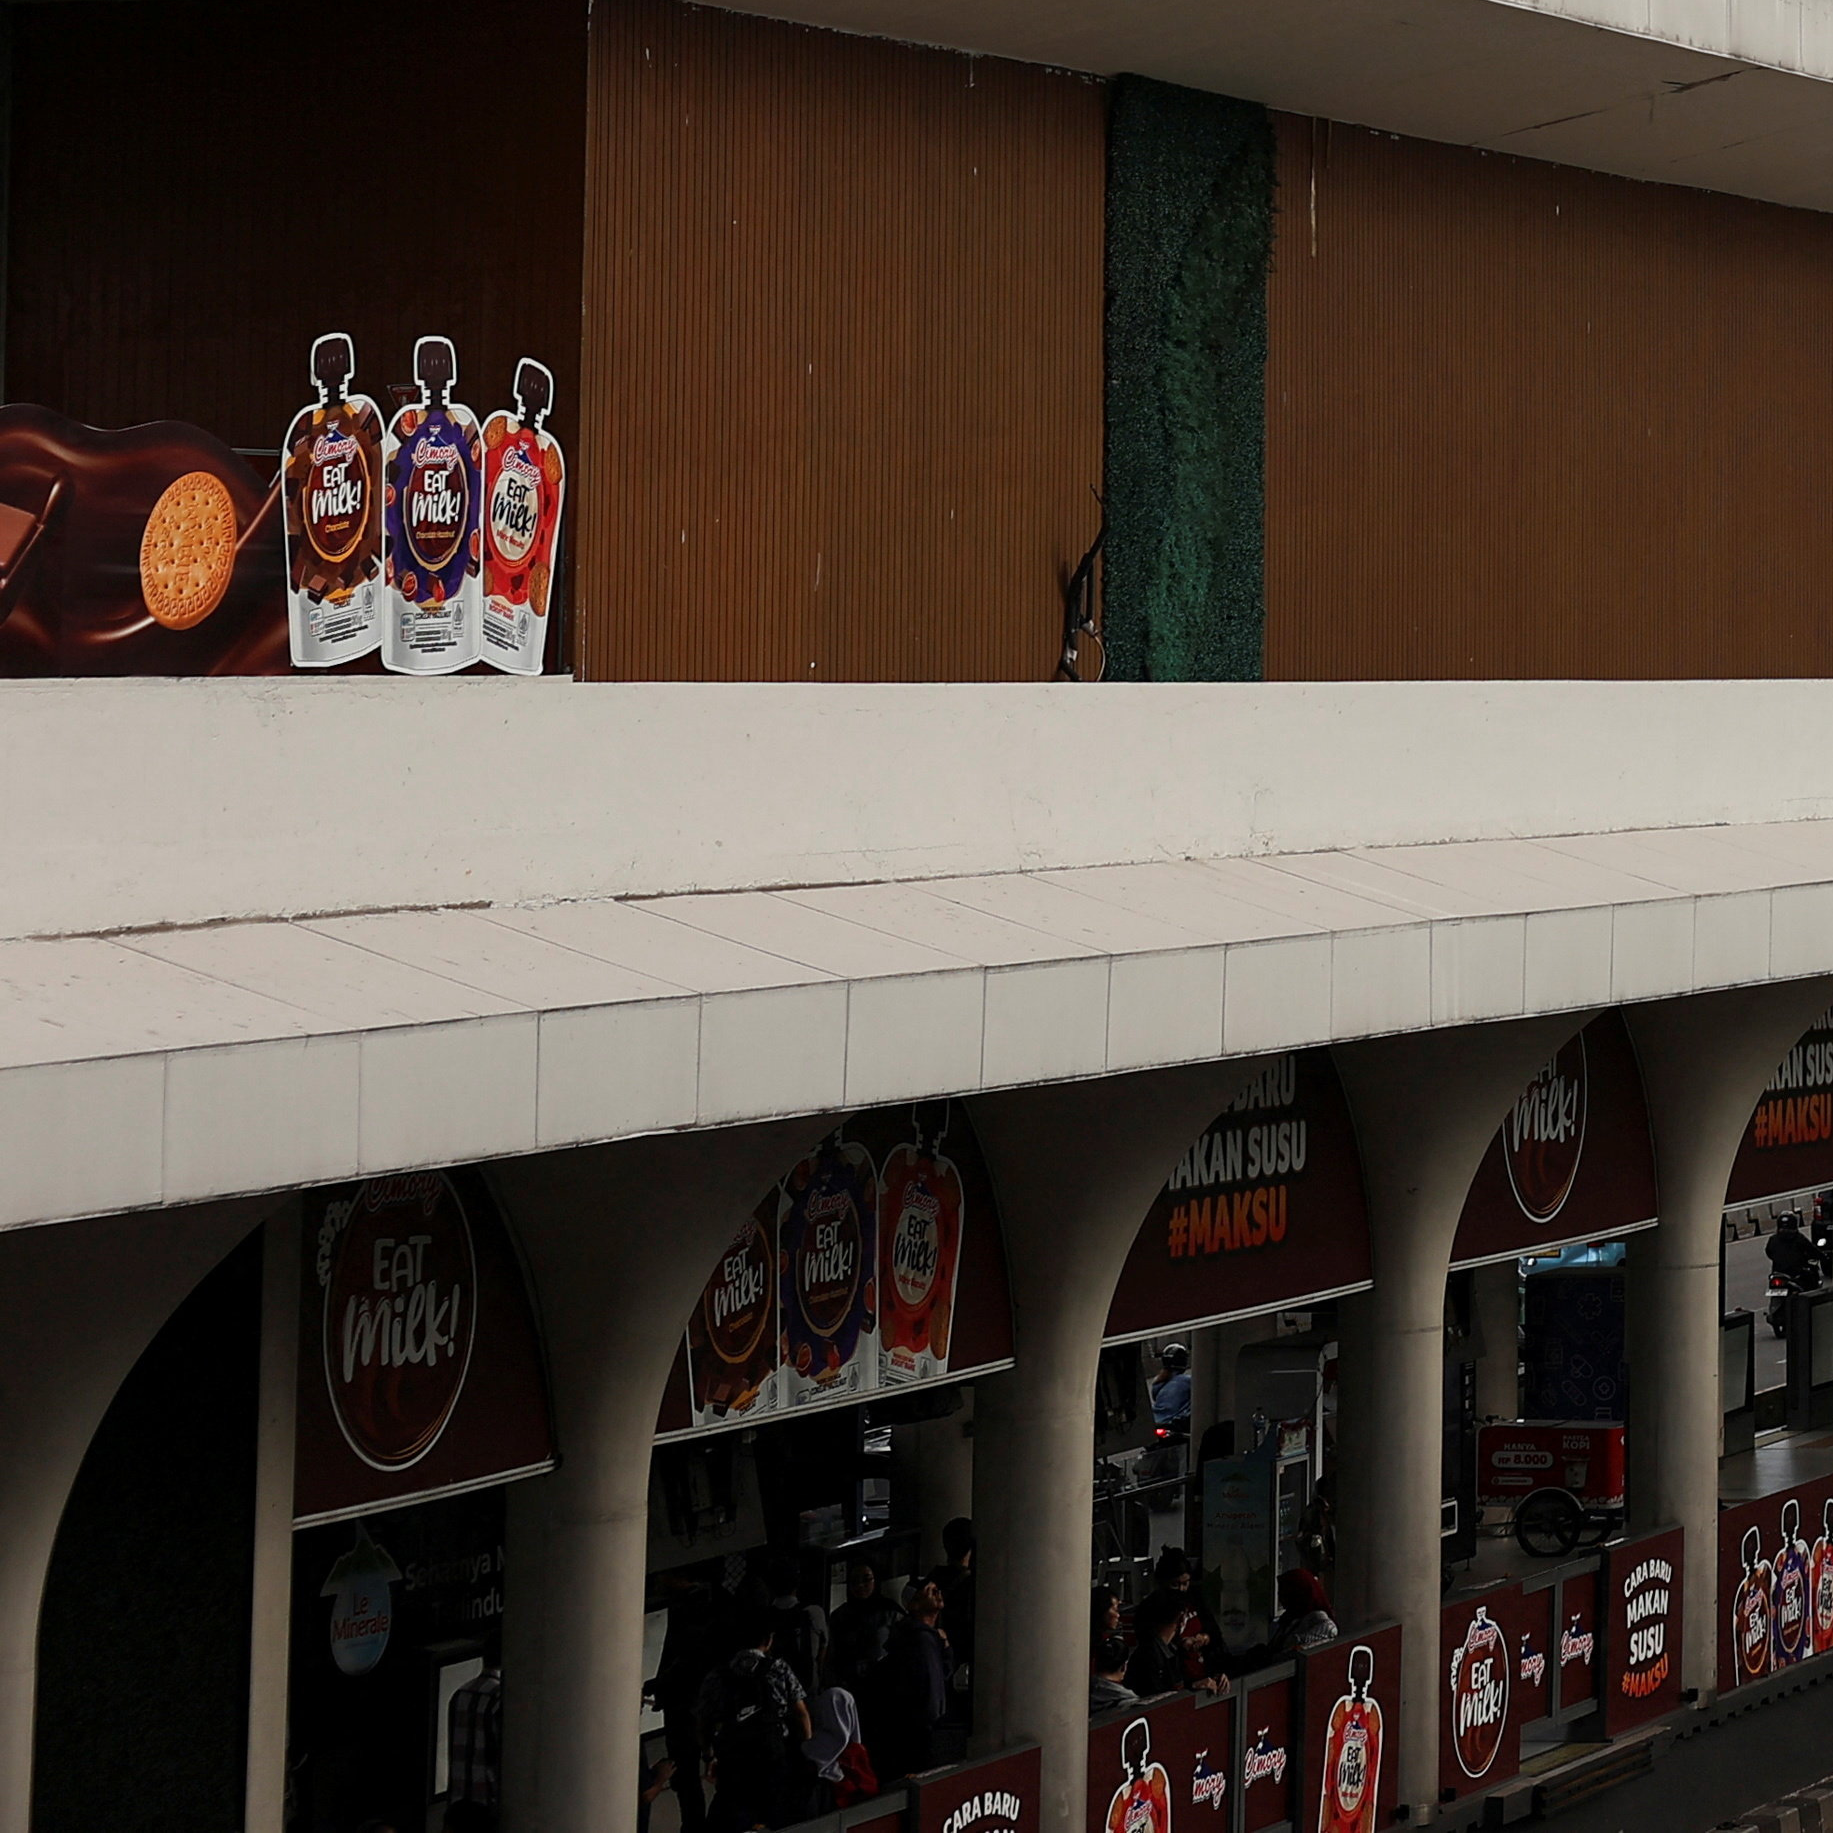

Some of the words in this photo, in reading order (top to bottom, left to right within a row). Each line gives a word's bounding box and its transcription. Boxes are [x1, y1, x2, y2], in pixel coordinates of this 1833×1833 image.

[313, 435, 358, 465] Cimory
[414, 437, 458, 469] Cimory
[502, 446, 541, 487] Cimory
[323, 462, 349, 487] EAT
[423, 470, 450, 494] EAT
[507, 478, 530, 499] EAT
[1754, 1093, 1833, 1148] #MAKSU
[1168, 1129, 1244, 1192] AKAN
[1247, 1119, 1307, 1181] SUSU
[816, 1220, 842, 1249] EAT
[907, 1215, 930, 1238] EAT
[1168, 1184, 1289, 1259] #MAKSU
[372, 1234, 432, 1293] EAT
[723, 1247, 749, 1280] EAT
[1514, 1454, 1547, 1464] 8.000
[1624, 1561, 1648, 1598] CARA
[1649, 1558, 1673, 1583] BARU
[353, 1595, 369, 1616] Le
[1626, 1588, 1669, 1629] MAKAN
[332, 1613, 388, 1642] Minerale
[1629, 1622, 1664, 1665] SUSU
[1471, 1657, 1494, 1690] EAT
[1621, 1652, 1670, 1698] #MAKSU
[1244, 1747, 1287, 1789] Cimory
[984, 1790, 1021, 1822] BARU
[1192, 1771, 1226, 1810] imory
